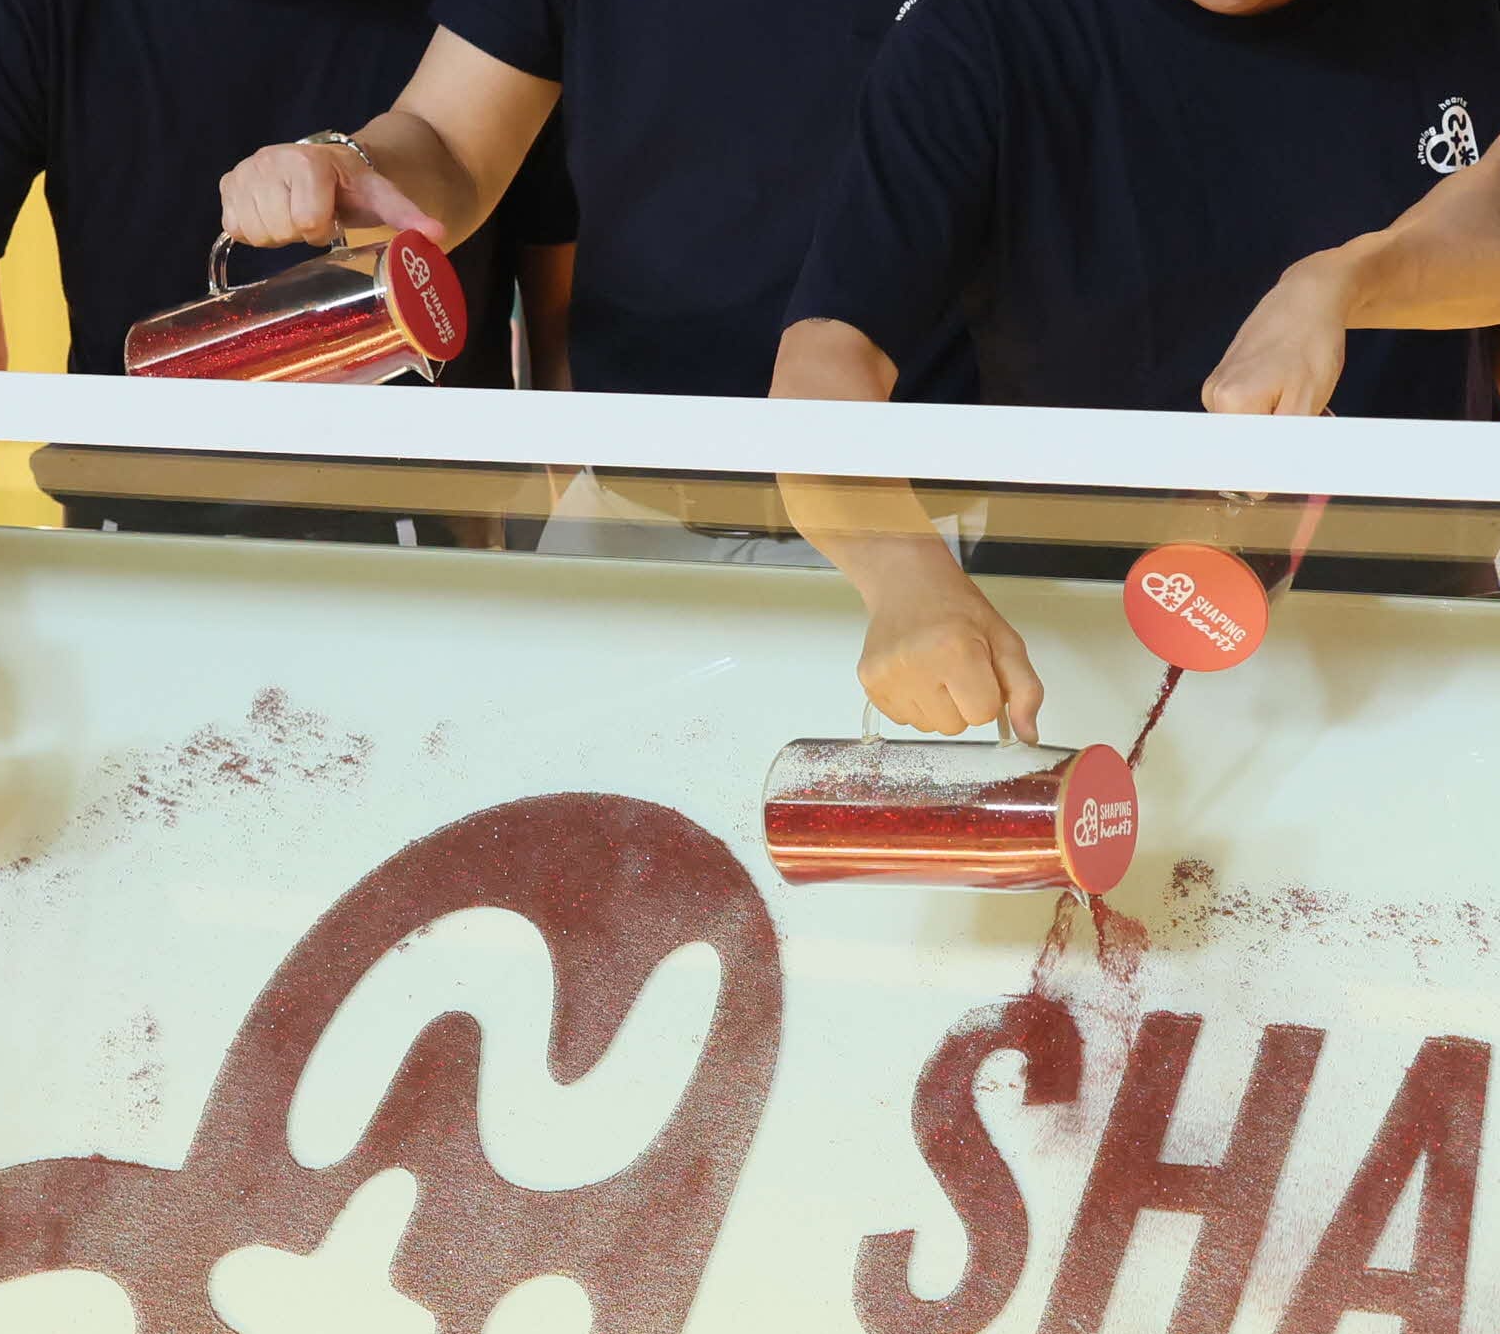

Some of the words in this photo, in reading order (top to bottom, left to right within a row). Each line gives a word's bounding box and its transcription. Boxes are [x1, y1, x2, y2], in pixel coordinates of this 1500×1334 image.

[427, 284, 456, 341] SHAPING
[1179, 606, 1237, 652] hearts
[1192, 595, 1247, 643] SHAPING
[1099, 799, 1132, 820] SHAPING
